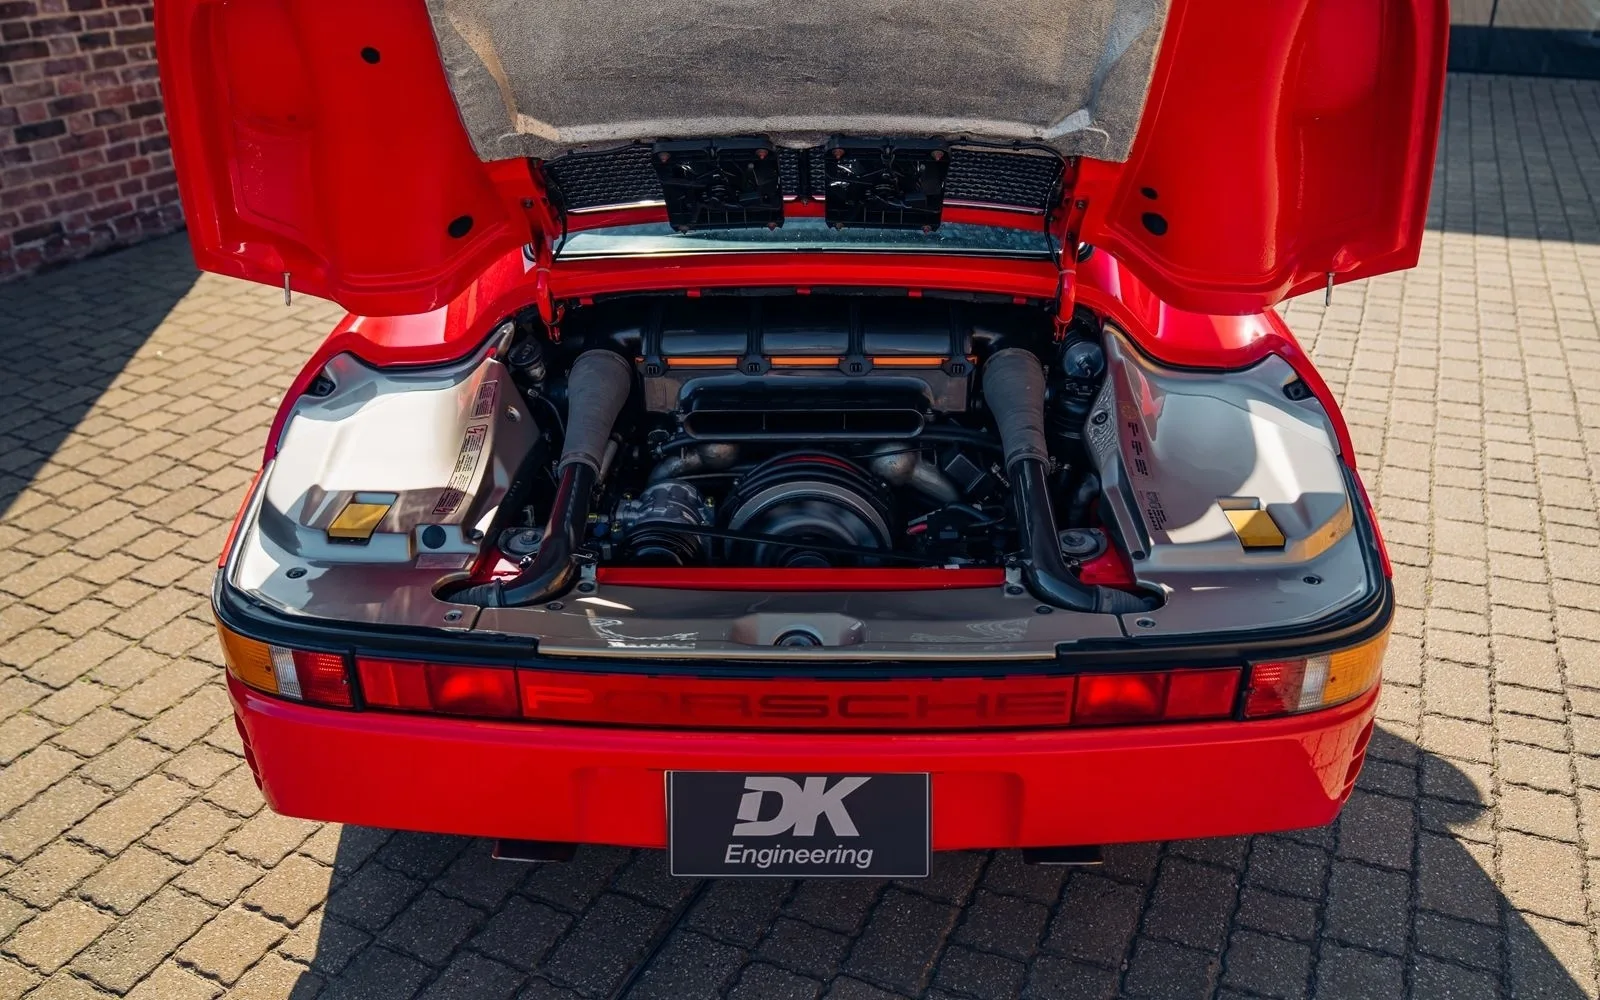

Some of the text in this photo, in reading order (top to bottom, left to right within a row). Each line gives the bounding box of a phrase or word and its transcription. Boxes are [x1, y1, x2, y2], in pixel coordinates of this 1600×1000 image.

[526, 685, 1067, 719] PORSCHE
[732, 776, 872, 837] DK
[724, 844, 873, 869] Engineering
